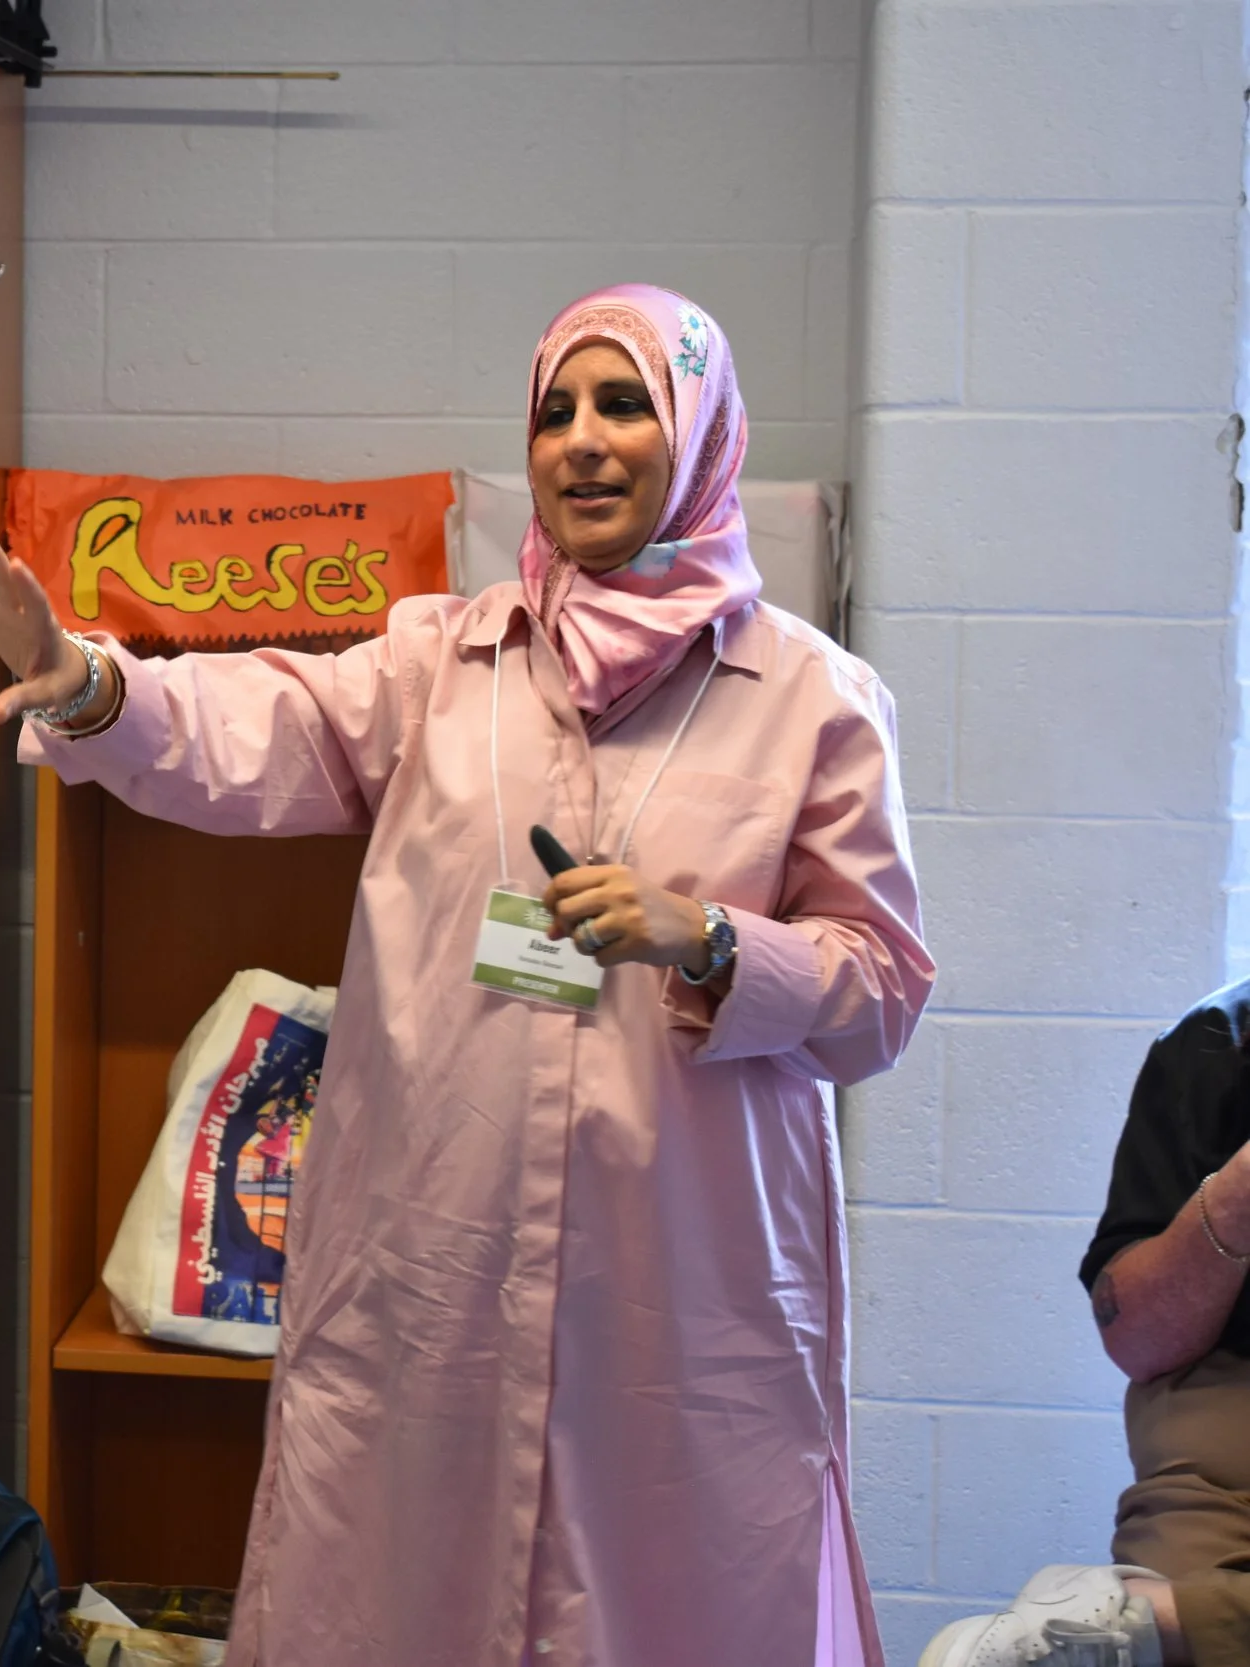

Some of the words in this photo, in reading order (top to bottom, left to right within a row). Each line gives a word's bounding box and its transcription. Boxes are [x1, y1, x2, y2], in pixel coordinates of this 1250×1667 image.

[175, 507, 233, 525] MILK
[247, 503, 367, 524] CHOCOLATE
[186, 1170, 224, 1286] الفلسطيني
